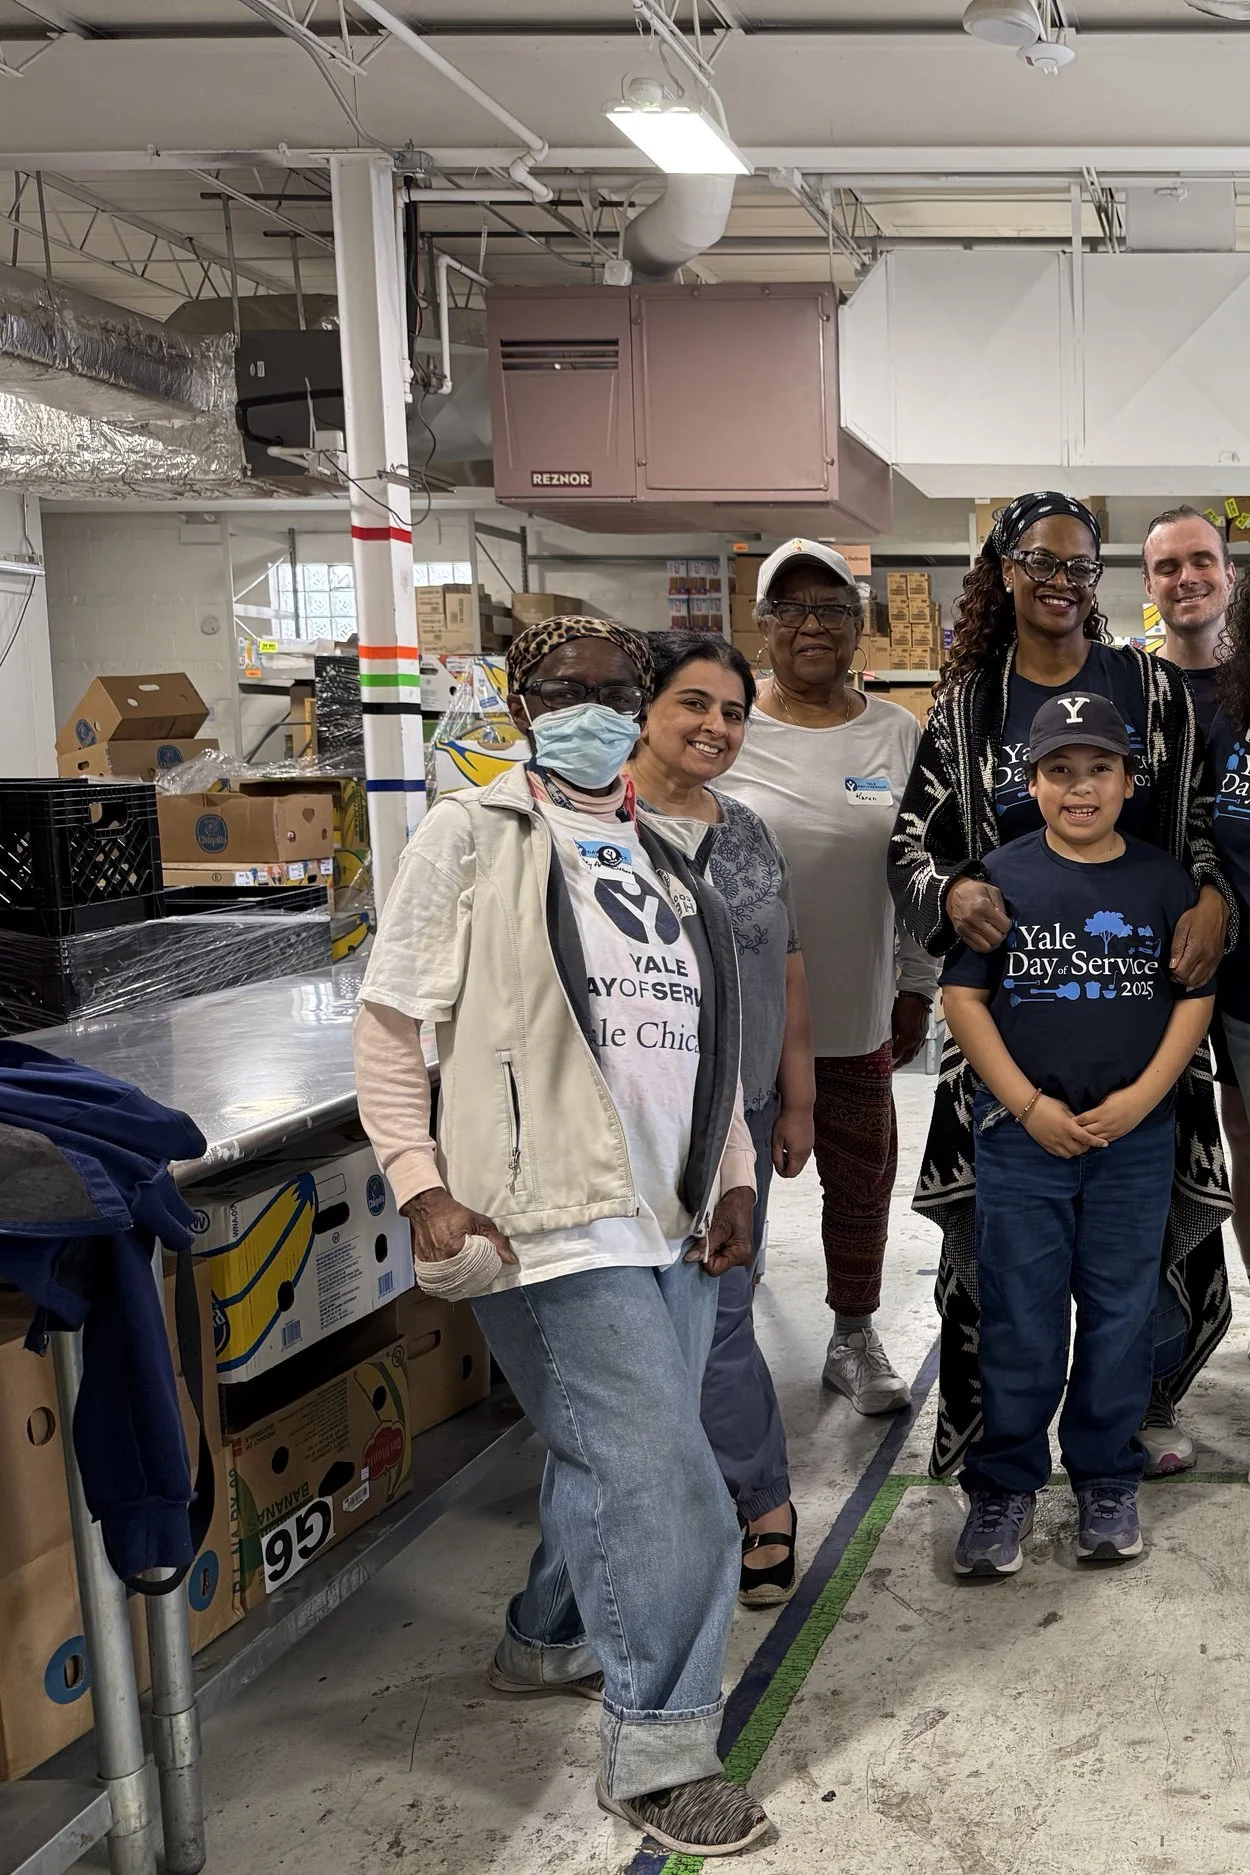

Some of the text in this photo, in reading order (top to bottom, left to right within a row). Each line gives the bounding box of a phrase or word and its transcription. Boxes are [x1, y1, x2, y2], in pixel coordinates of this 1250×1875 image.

[533, 473, 590, 485] REZNOR
[1057, 697, 1090, 723] Y
[1019, 923, 1076, 950] Yale
[629, 952, 689, 977] YALE
[1007, 950, 1159, 984] Day of Service
[1121, 980, 1155, 1000] 2025
[265, 1500, 332, 1583] G6
